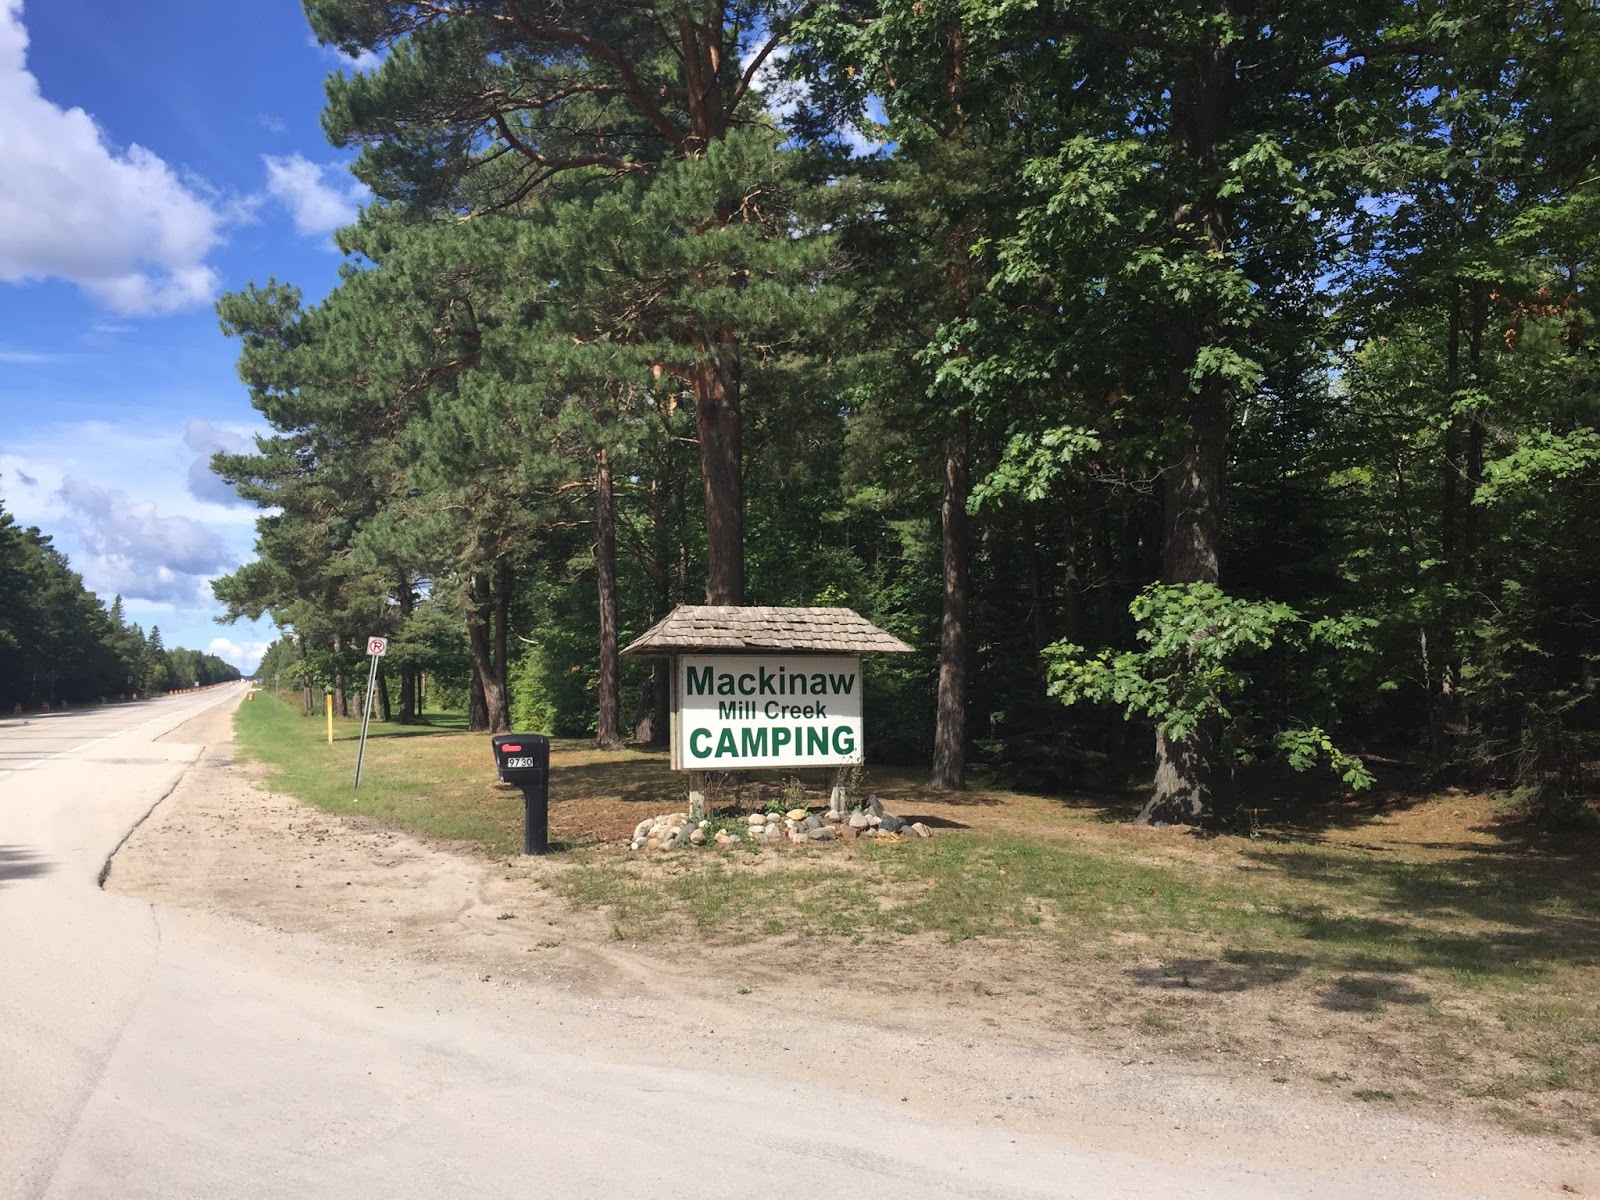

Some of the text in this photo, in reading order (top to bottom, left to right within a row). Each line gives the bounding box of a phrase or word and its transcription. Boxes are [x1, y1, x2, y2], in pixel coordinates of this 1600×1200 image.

[686, 666, 855, 696] Mackinaw
[718, 700, 827, 720] Mill Creek
[689, 725, 855, 759] CAMPING
[509, 758, 533, 767] 9730
